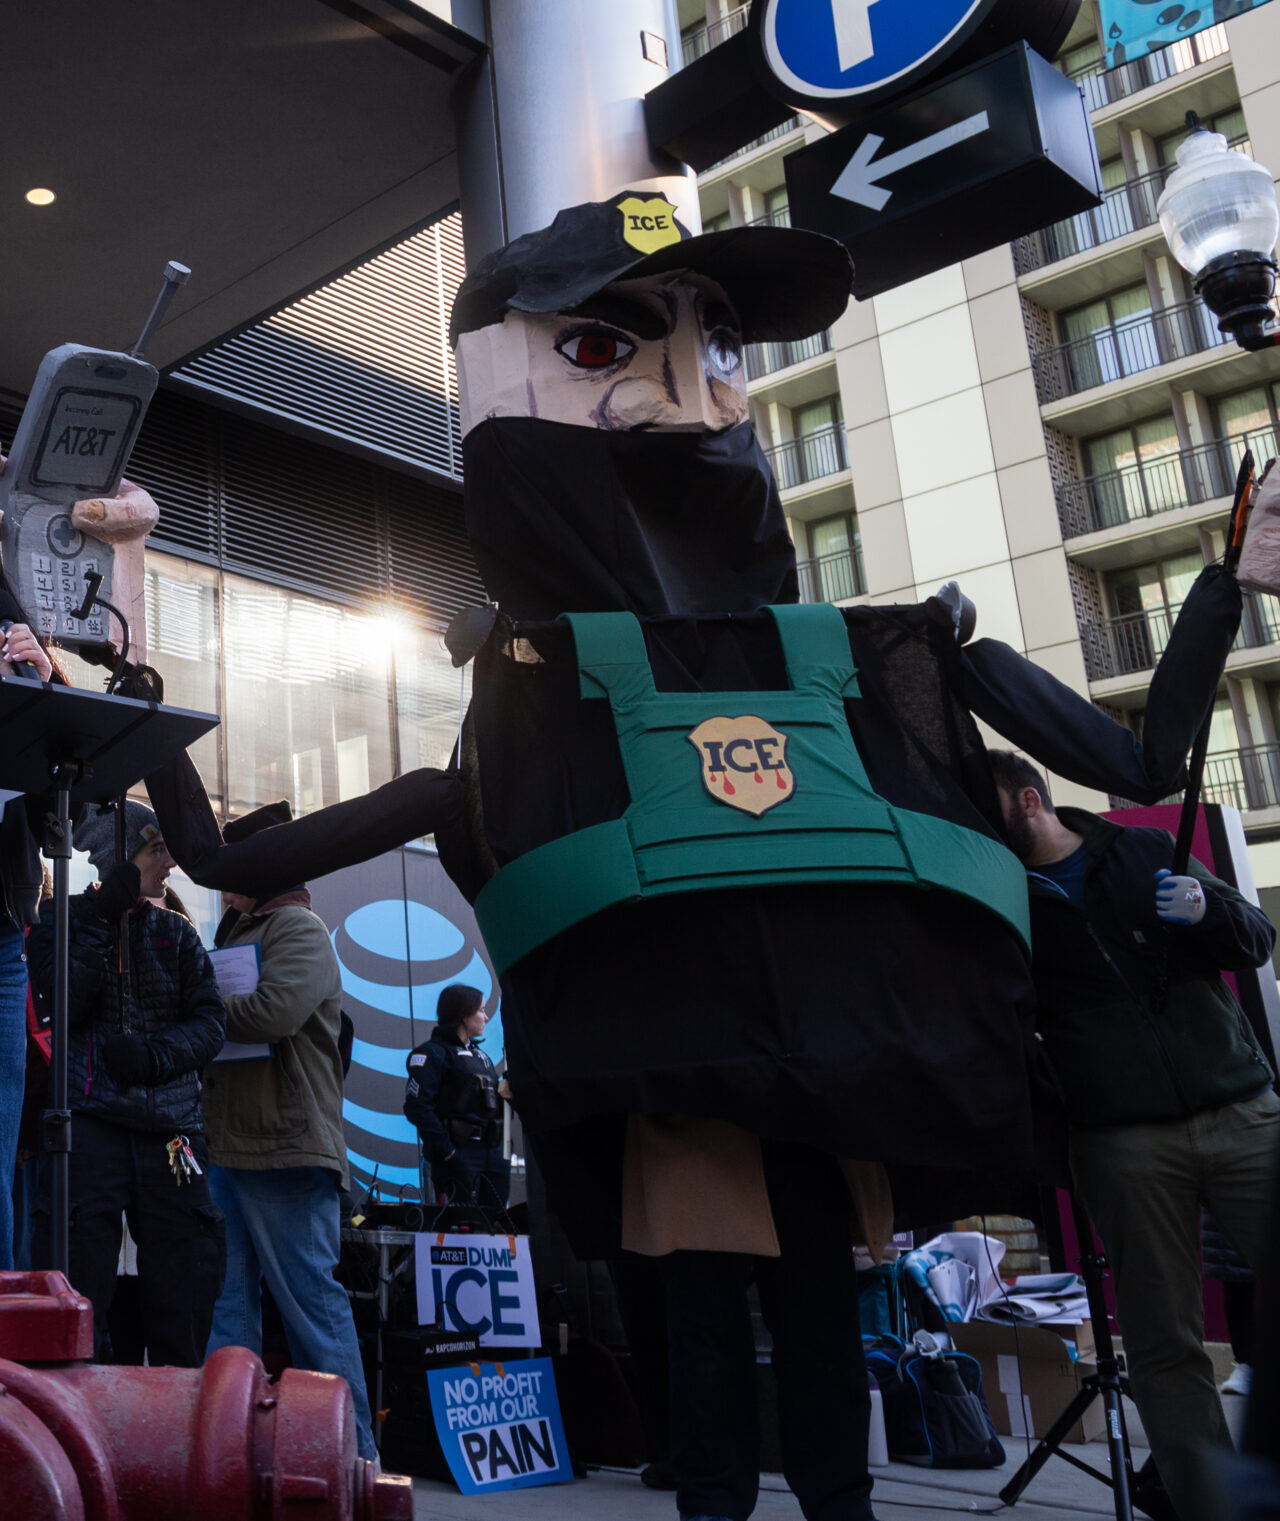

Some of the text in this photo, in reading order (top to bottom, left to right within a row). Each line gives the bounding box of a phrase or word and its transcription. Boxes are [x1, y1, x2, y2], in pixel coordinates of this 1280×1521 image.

[628, 215, 669, 231] ICE
[52, 425, 116, 456] AT&T
[703, 737, 786, 773] ICE
[431, 1268, 526, 1337] ICE
[444, 1371, 542, 1406] NO PROFIT
[446, 1395, 539, 1430] FROM OUR
[461, 1419, 556, 1482] PAIN
